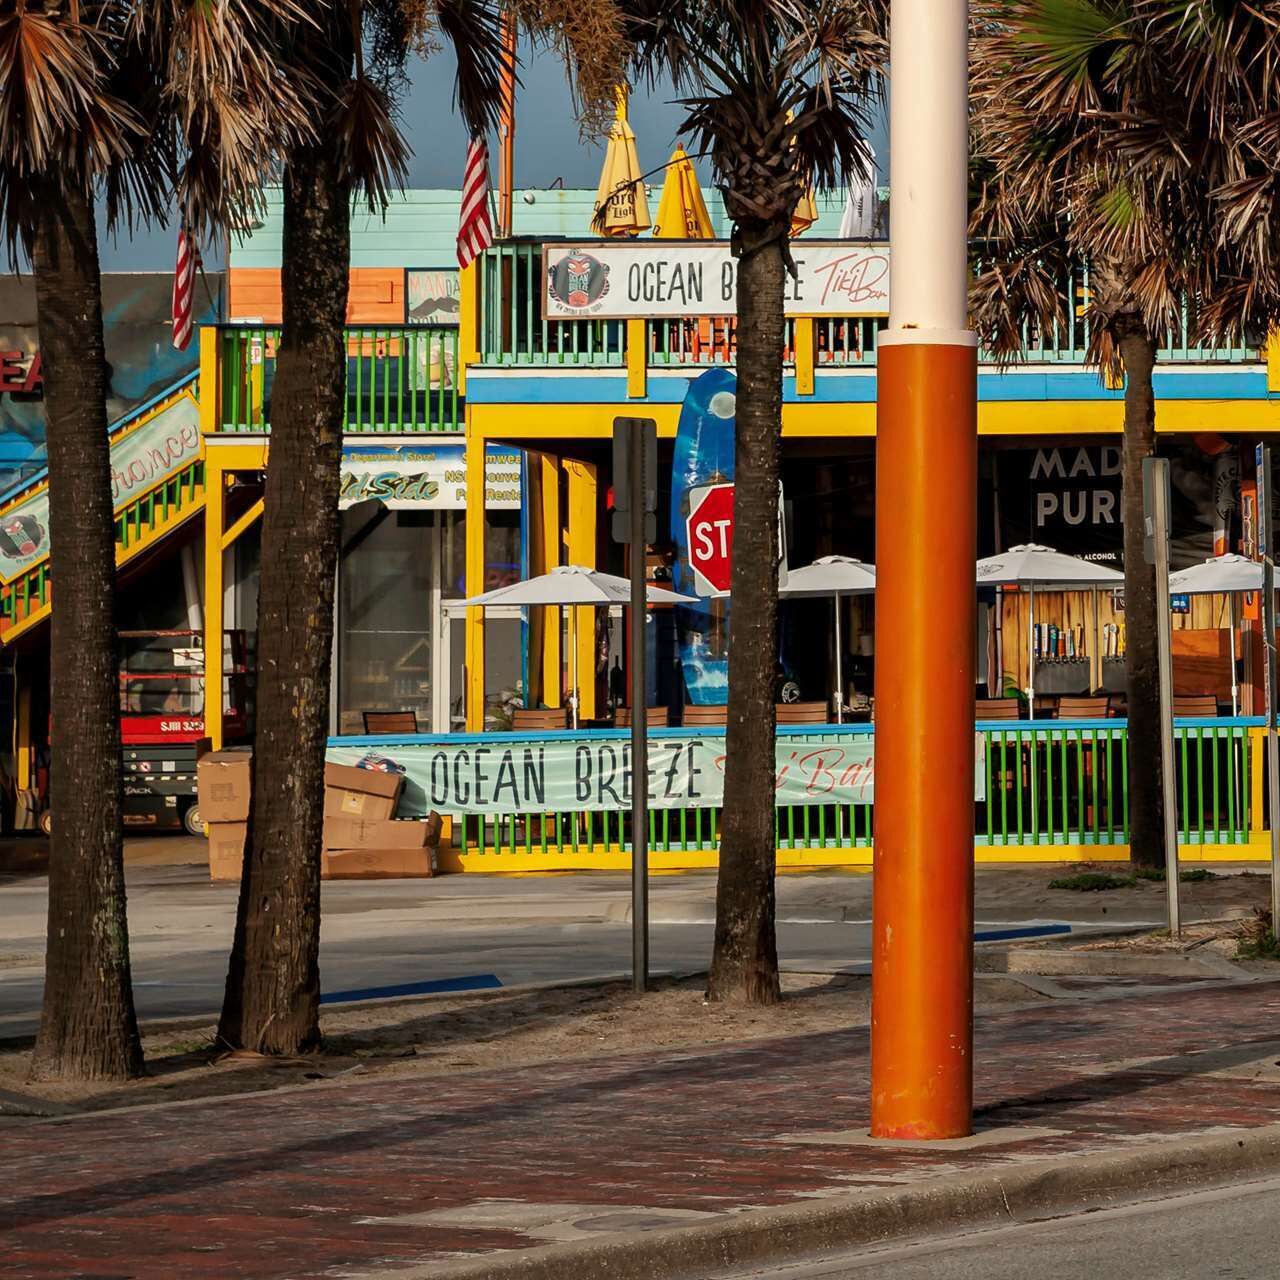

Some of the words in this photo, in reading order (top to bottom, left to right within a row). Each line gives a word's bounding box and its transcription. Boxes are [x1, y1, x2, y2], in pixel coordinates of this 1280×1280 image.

[628, 261, 703, 306] OCEAN
[814, 253, 862, 306] Tiki
[1029, 446, 1122, 479] MAD
[370, 472, 440, 501] Side
[1036, 489, 1124, 526] PUR
[695, 519, 732, 562] ST
[1084, 553, 1117, 561] ALCOHOL
[430, 747, 546, 810] OCEAN
